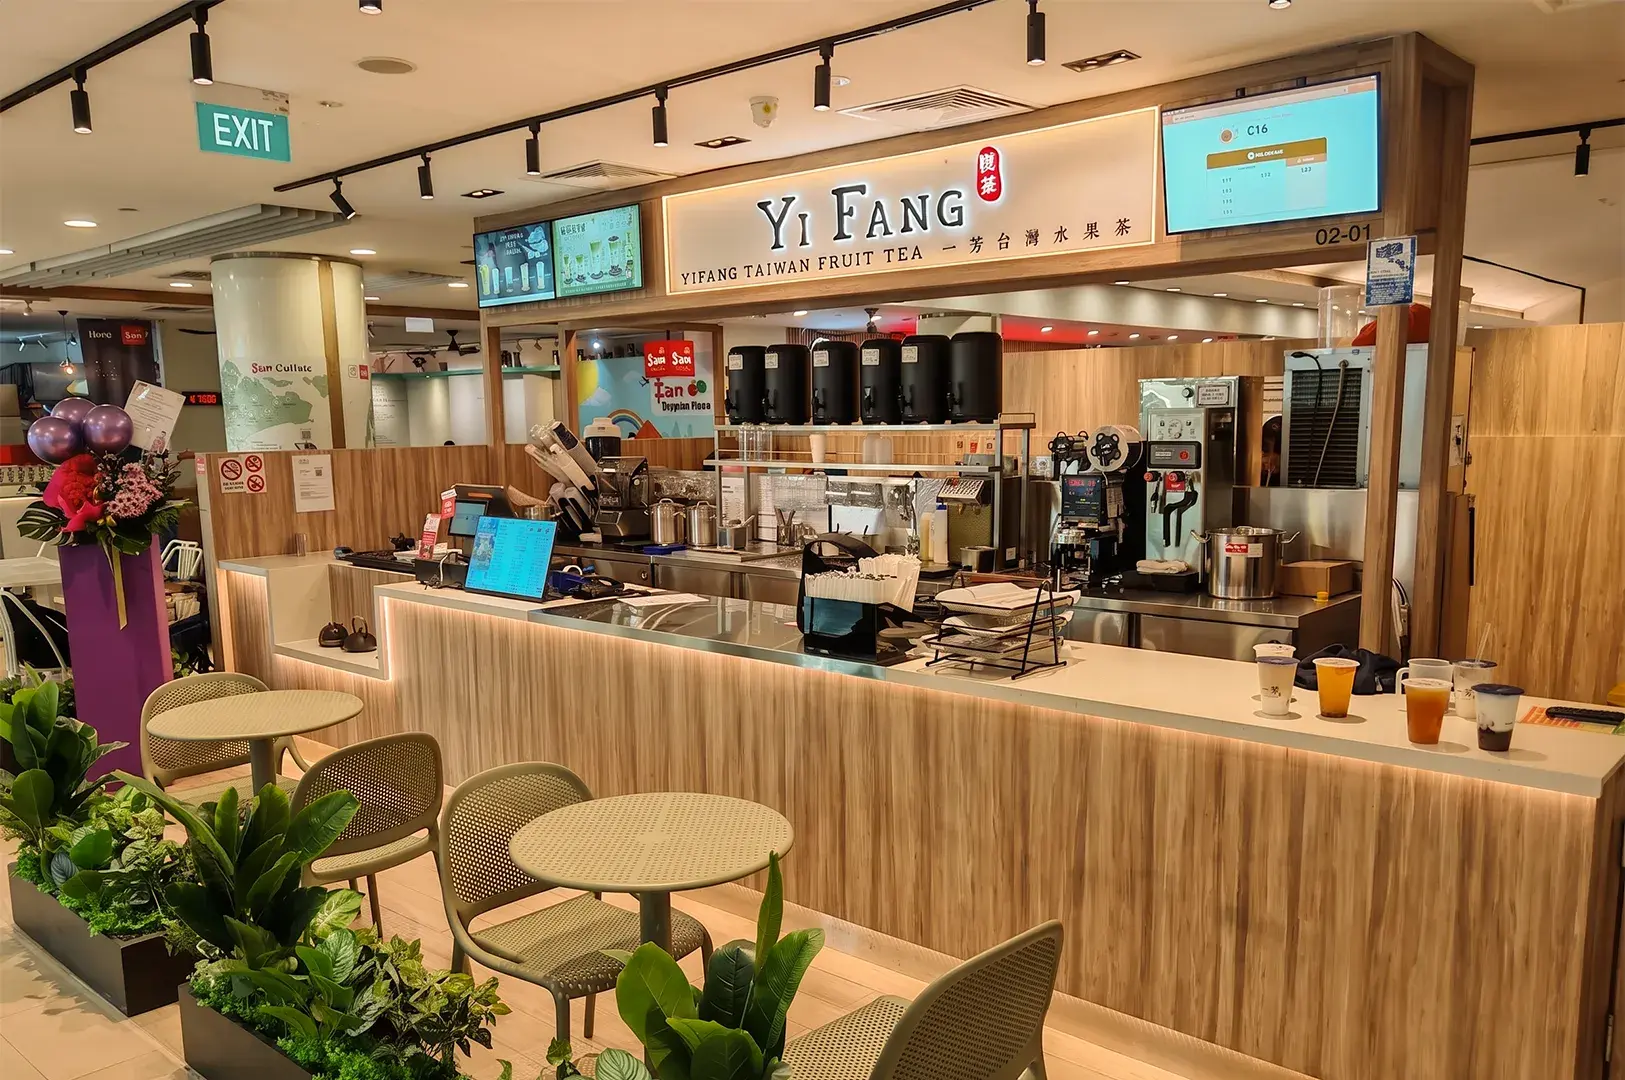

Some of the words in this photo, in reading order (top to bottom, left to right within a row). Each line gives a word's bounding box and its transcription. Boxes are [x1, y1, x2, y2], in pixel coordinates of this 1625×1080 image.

[213, 112, 273, 152] EXIT
[1247, 124, 1268, 135] C16
[1315, 224, 1371, 245] 02-01
[681, 267, 737, 285] YIFANG
[744, 258, 810, 278] TAIWAN
[818, 251, 874, 271] FRUIT
[884, 245, 923, 263] TEA
[942, 218, 1132, 254] 一芳台灣水果茶
